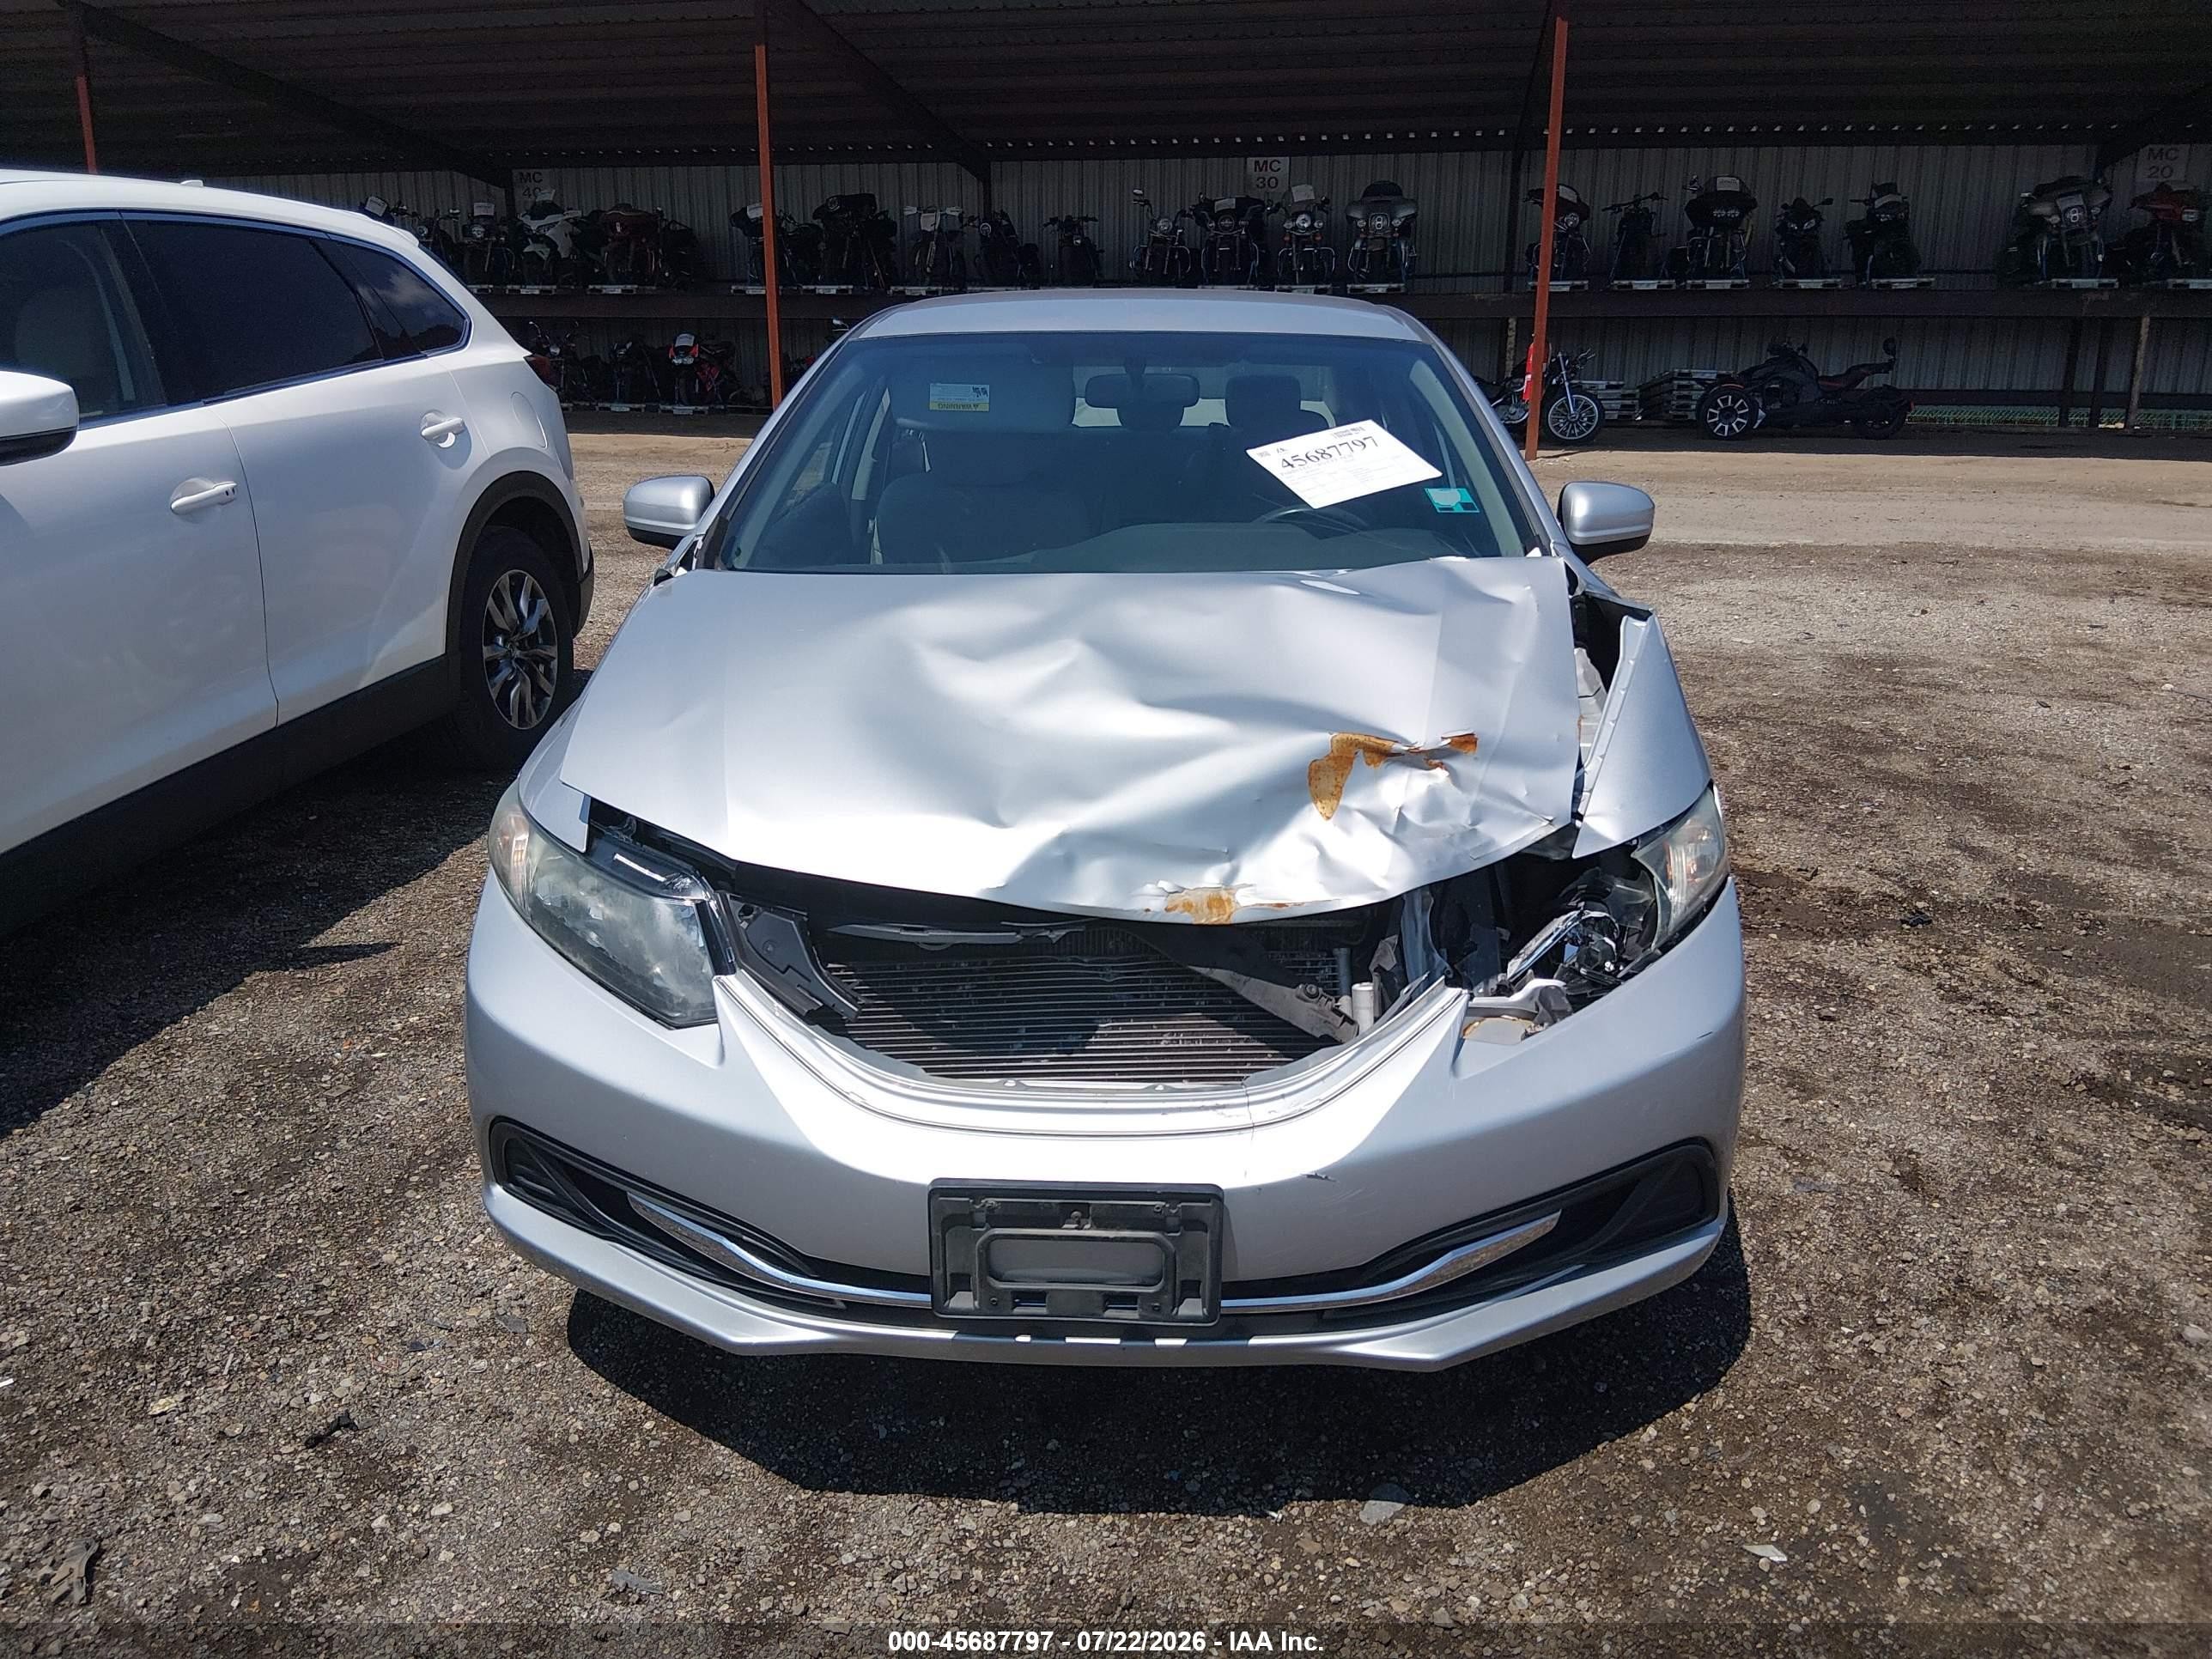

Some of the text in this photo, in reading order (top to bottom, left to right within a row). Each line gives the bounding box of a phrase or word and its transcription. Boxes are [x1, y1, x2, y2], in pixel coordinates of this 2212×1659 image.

[2148, 148, 2179, 161] MC
[1254, 160, 1282, 172] MC
[2147, 165, 2174, 179] 20
[520, 172, 543, 183] MC
[1256, 176, 1279, 189] 30
[1280, 435, 1377, 470] 45687797
